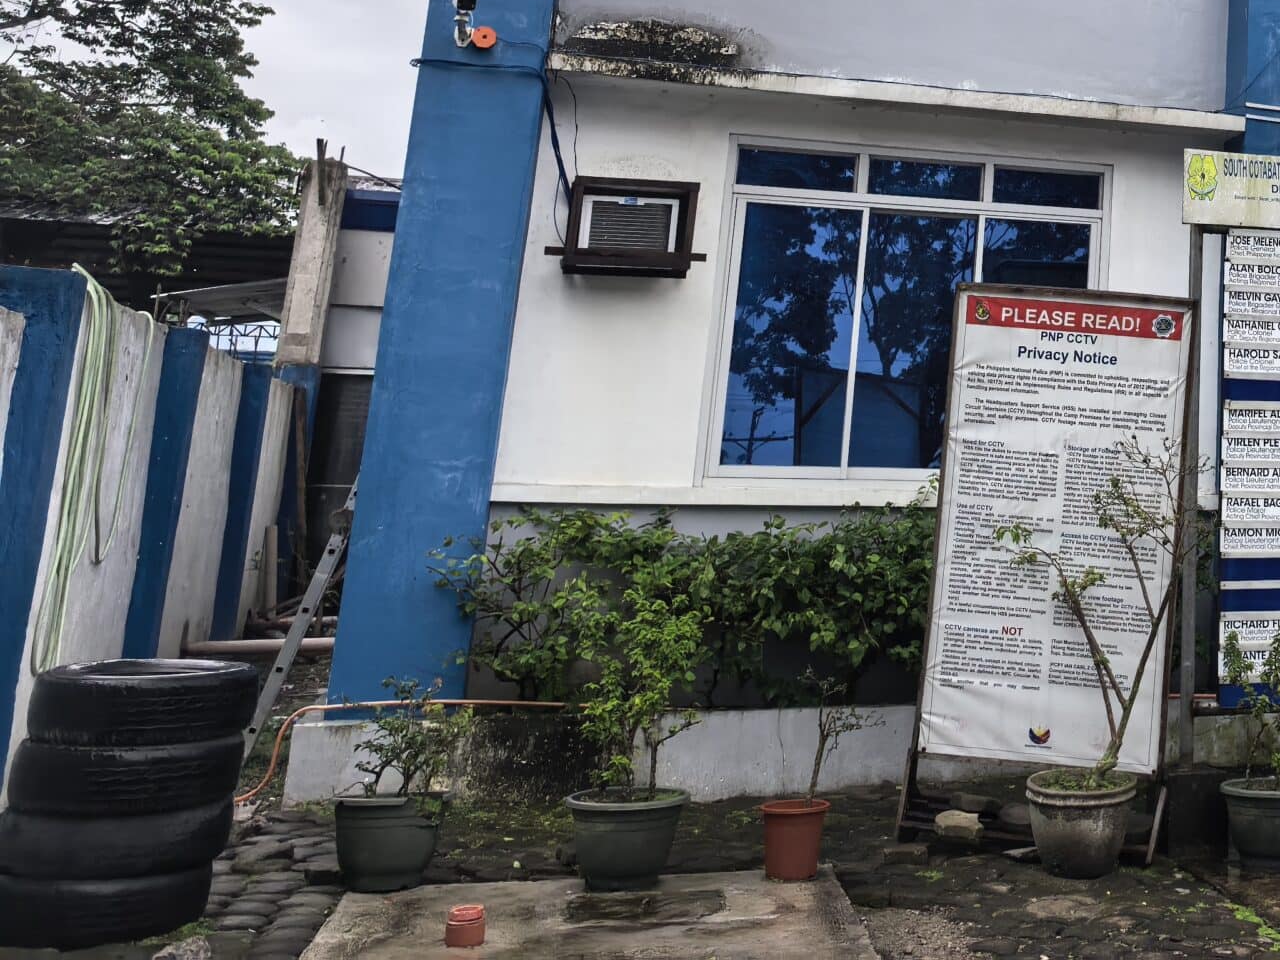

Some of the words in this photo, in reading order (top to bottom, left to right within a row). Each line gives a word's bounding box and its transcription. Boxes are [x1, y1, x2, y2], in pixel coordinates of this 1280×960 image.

[1224, 158, 1248, 178] SOUTH
[1231, 236, 1251, 246] JOSE
[1229, 264, 1255, 273] ALAN
[1229, 291, 1262, 301] MELVIN
[1000, 306, 1076, 327] PLEASE
[1081, 313, 1141, 332] READ!
[1227, 320, 1276, 331] NATHANIEL
[1040, 331, 1064, 342] PNP
[1066, 333, 1098, 344] CCTV
[1017, 345, 1069, 364] Privacy
[1073, 350, 1118, 365] Notice
[1229, 348, 1270, 359] HAROLD
[1228, 409, 1268, 418] MARIFEL
[1227, 438, 1260, 447] VIRLEN
[1225, 468, 1269, 477] BERNARD
[1226, 497, 1261, 507] RAFAEL
[1224, 528, 1262, 537] RAMON
[1224, 620, 1270, 629] RICHARD
[1001, 626, 1024, 636] NOT
